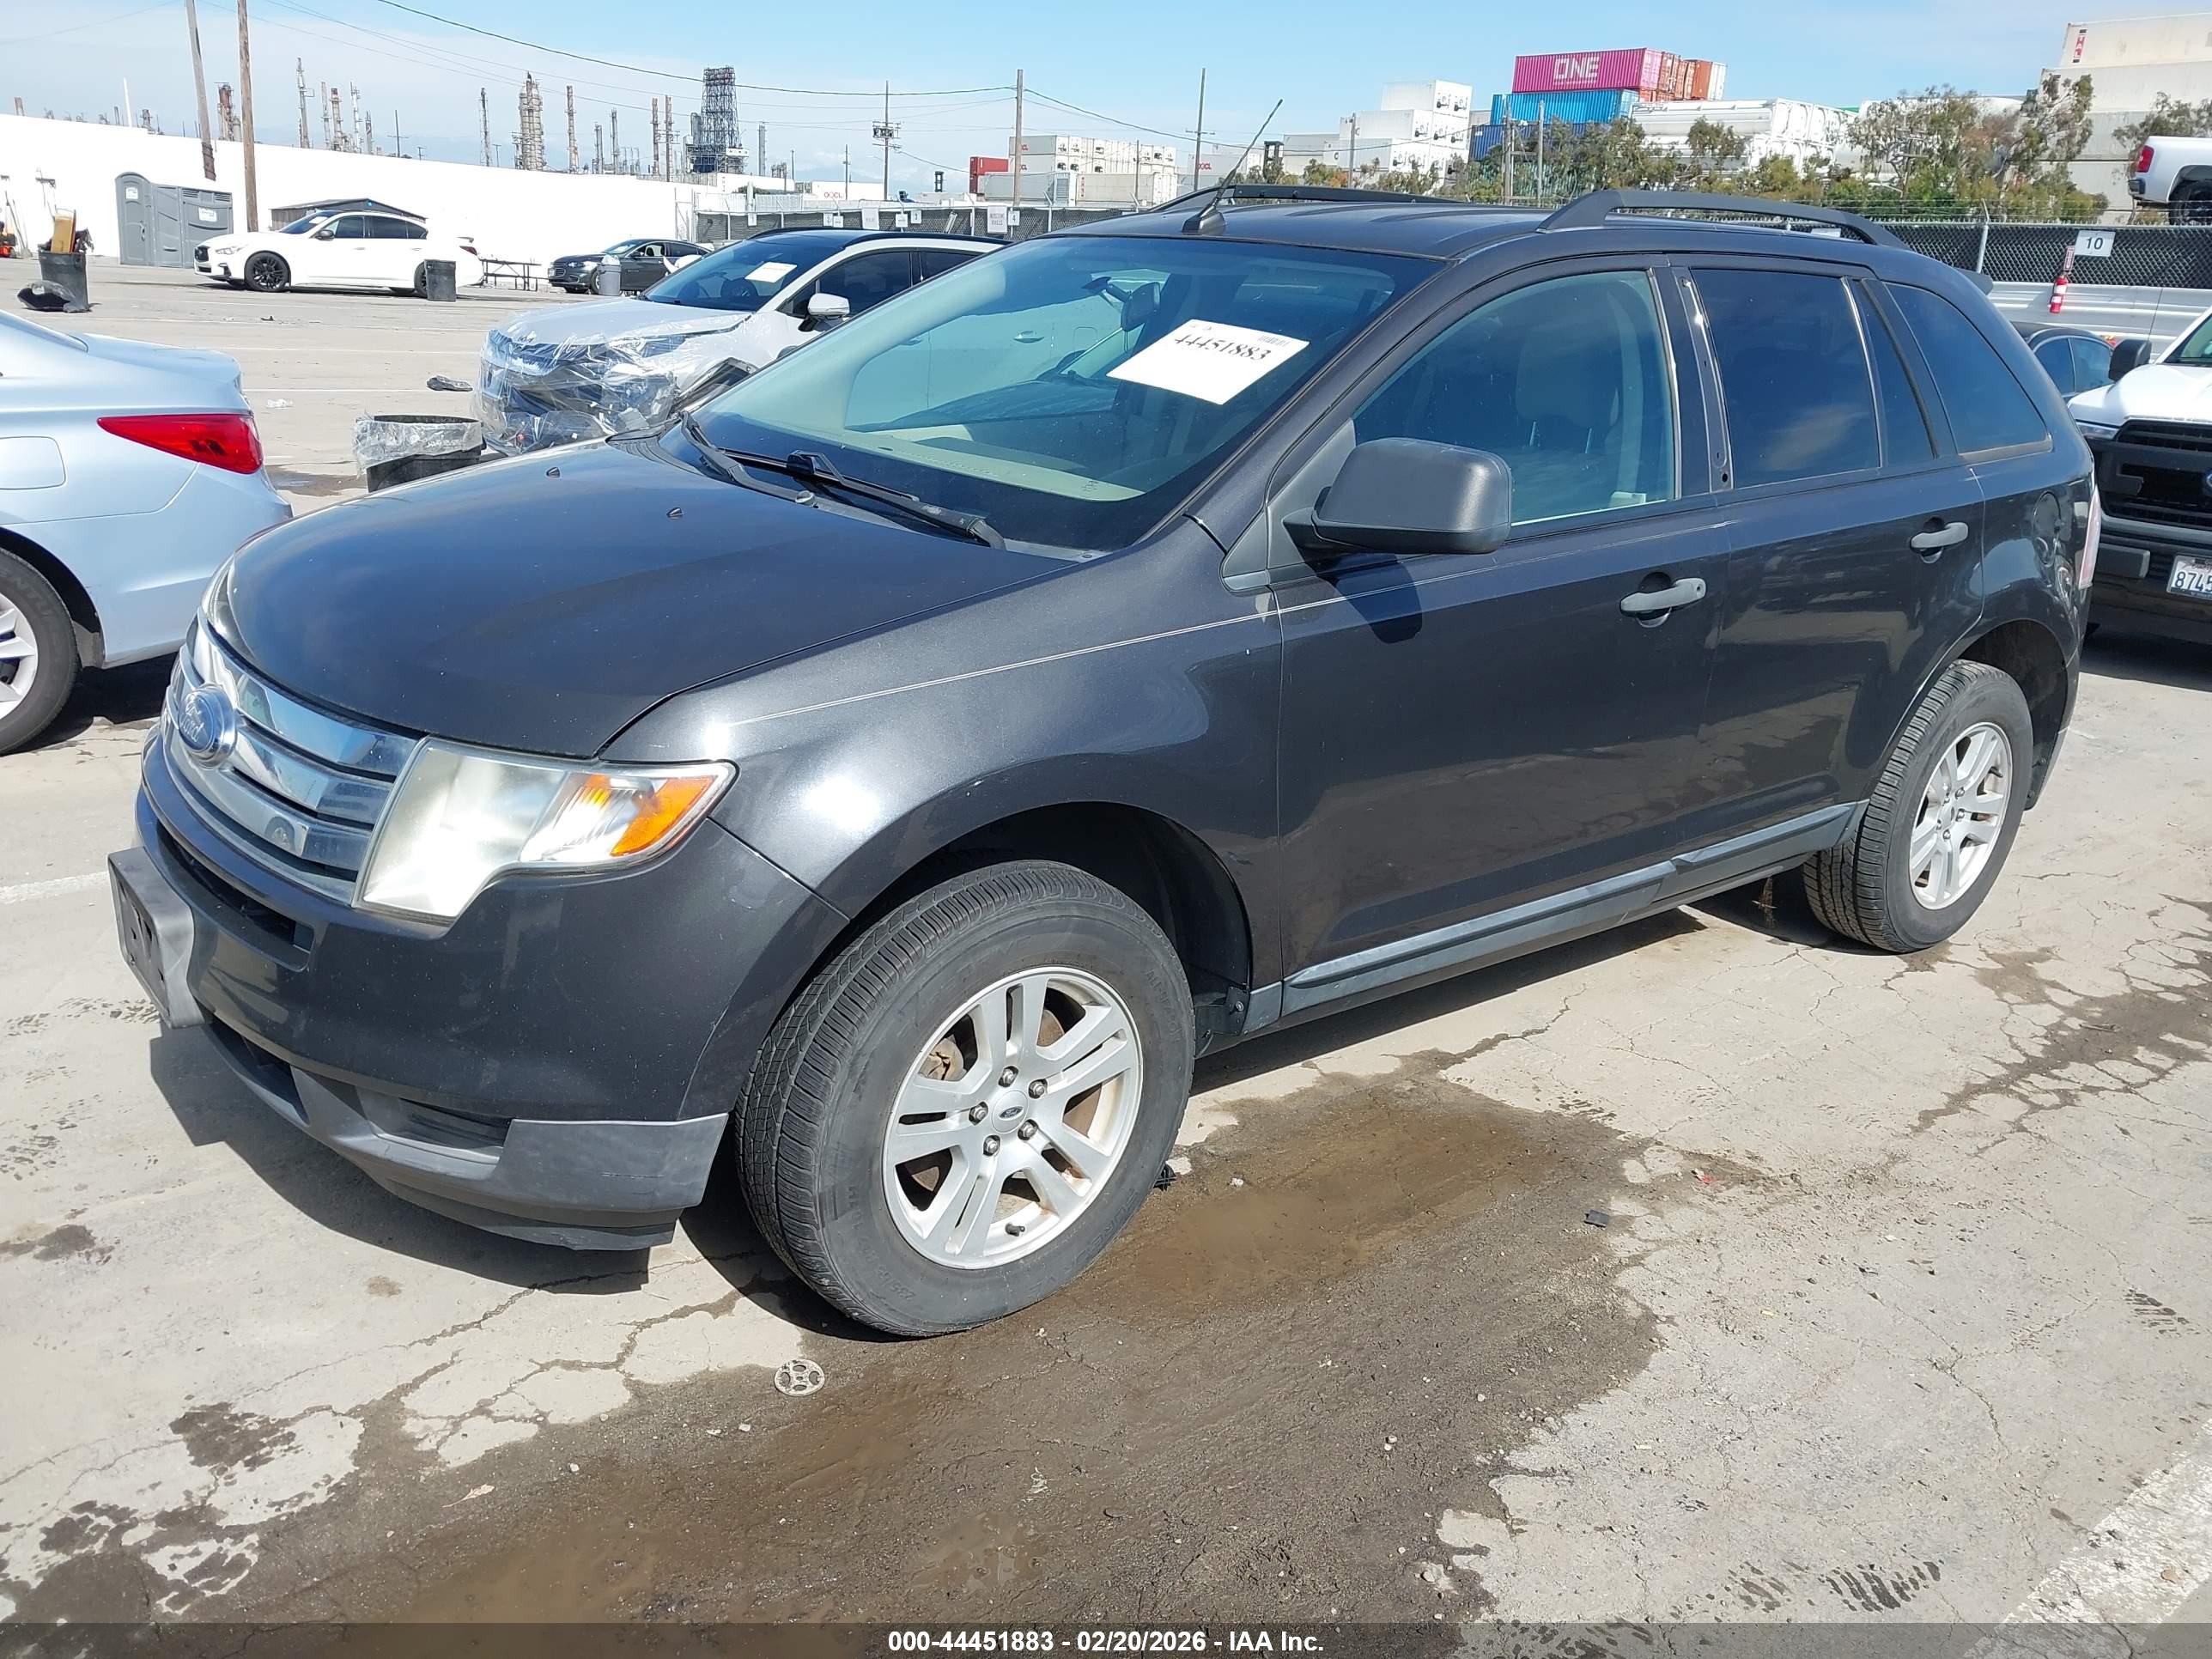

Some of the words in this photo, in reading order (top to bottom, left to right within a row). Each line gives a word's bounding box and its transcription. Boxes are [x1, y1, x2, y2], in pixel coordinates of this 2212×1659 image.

[1553, 57, 1600, 79] ONE
[2086, 237, 2104, 250] 10
[1174, 334, 1272, 361] 44451883
